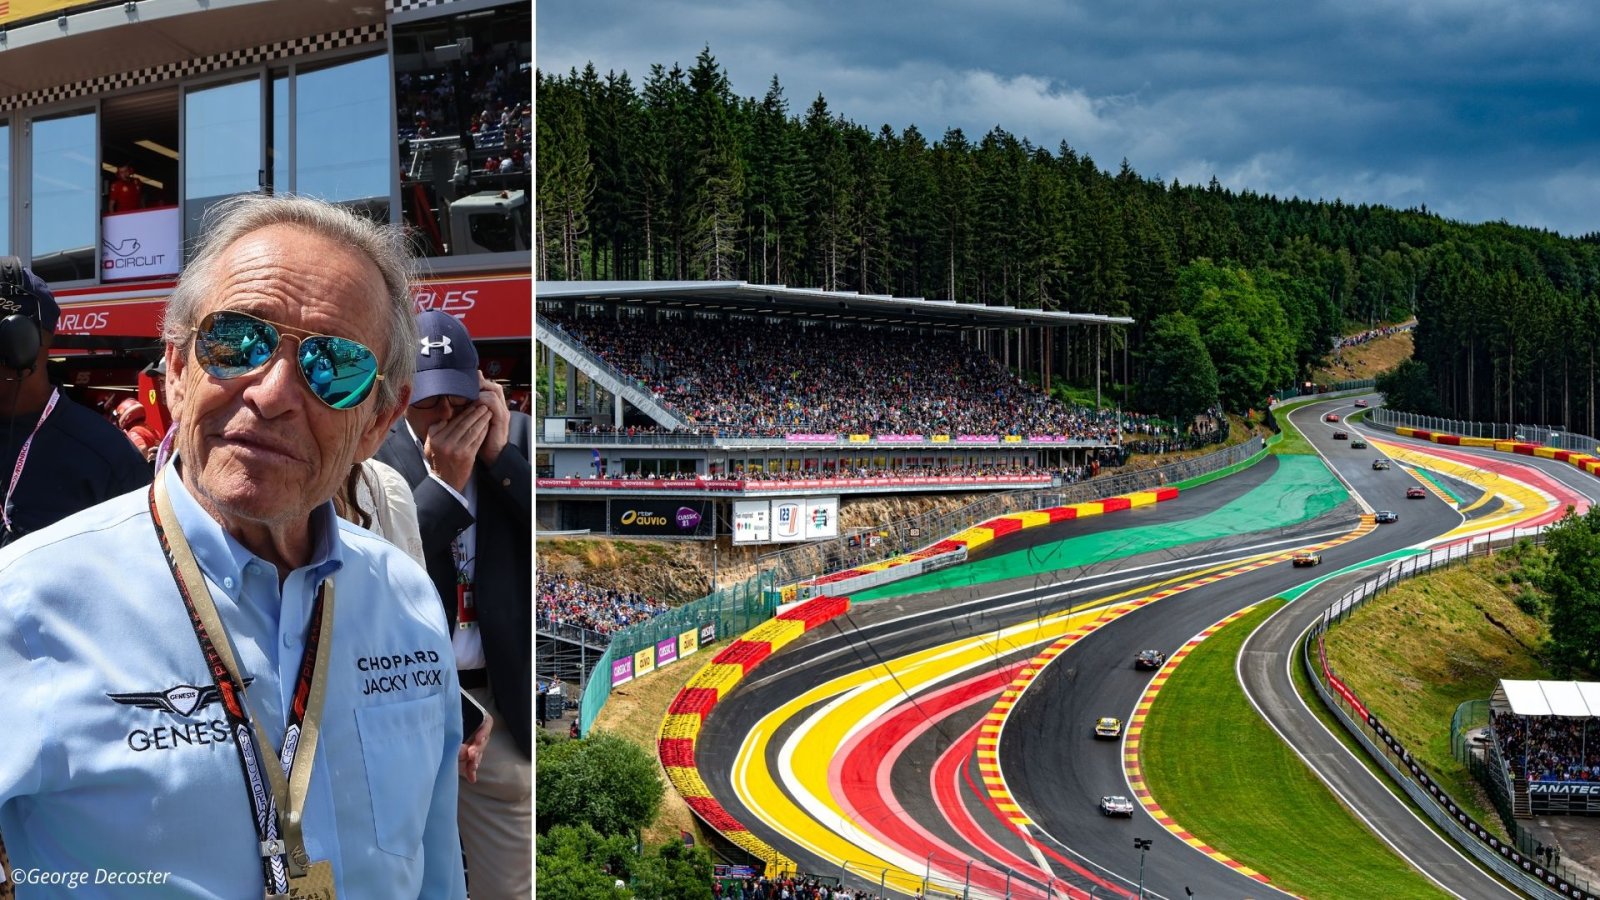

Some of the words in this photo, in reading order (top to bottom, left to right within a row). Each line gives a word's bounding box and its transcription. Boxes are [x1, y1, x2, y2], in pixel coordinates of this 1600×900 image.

[115, 254, 165, 269] CIRCUIT
[413, 290, 478, 311] RLES
[56, 312, 109, 330] ARLOS
[636, 516, 667, 526] auvio
[357, 650, 439, 671] CHOPARD
[363, 673, 407, 695] JACKY
[412, 669, 442, 687] ICKX
[169, 692, 196, 700] GENESIS
[128, 719, 227, 752] GENES
[240, 734, 260, 782] ACCESS
[1529, 784, 1600, 794] FANATEC
